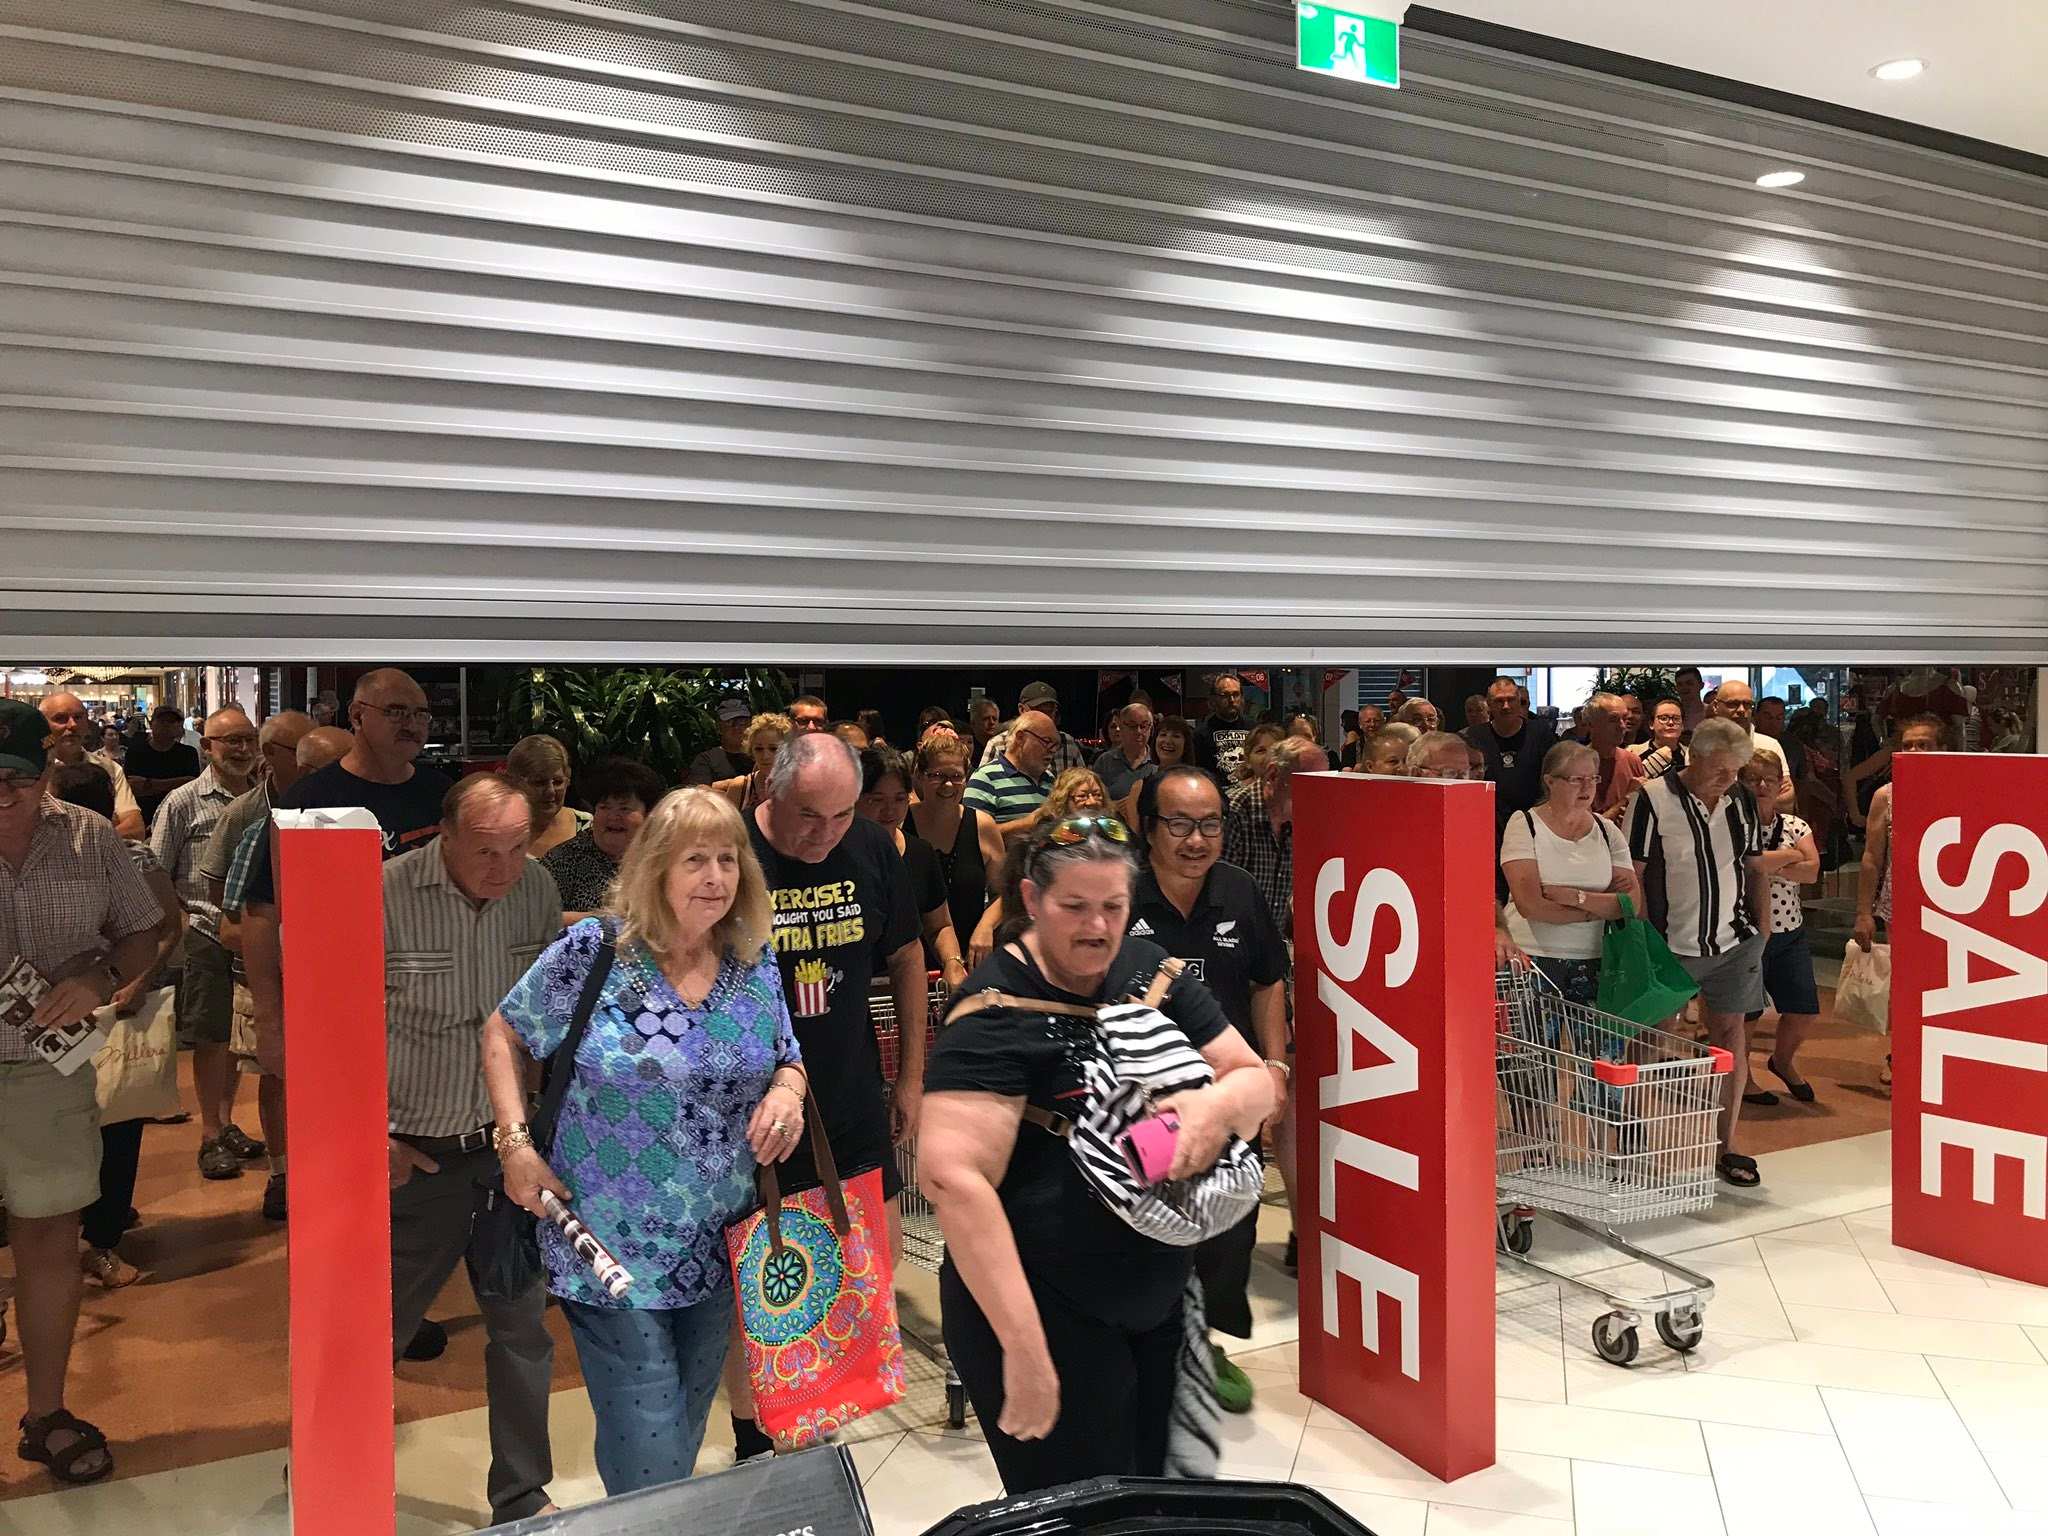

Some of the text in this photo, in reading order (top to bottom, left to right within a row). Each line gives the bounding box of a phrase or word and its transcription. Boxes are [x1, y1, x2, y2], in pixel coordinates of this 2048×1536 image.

[767, 880, 856, 911] XERCISE?
[811, 908, 834, 923] YOU
[1128, 928, 1155, 937] adidas
[767, 916, 865, 953] XTRA FRIES
[1918, 816, 2048, 1220] SALE
[1314, 857, 1420, 1382] SALE
